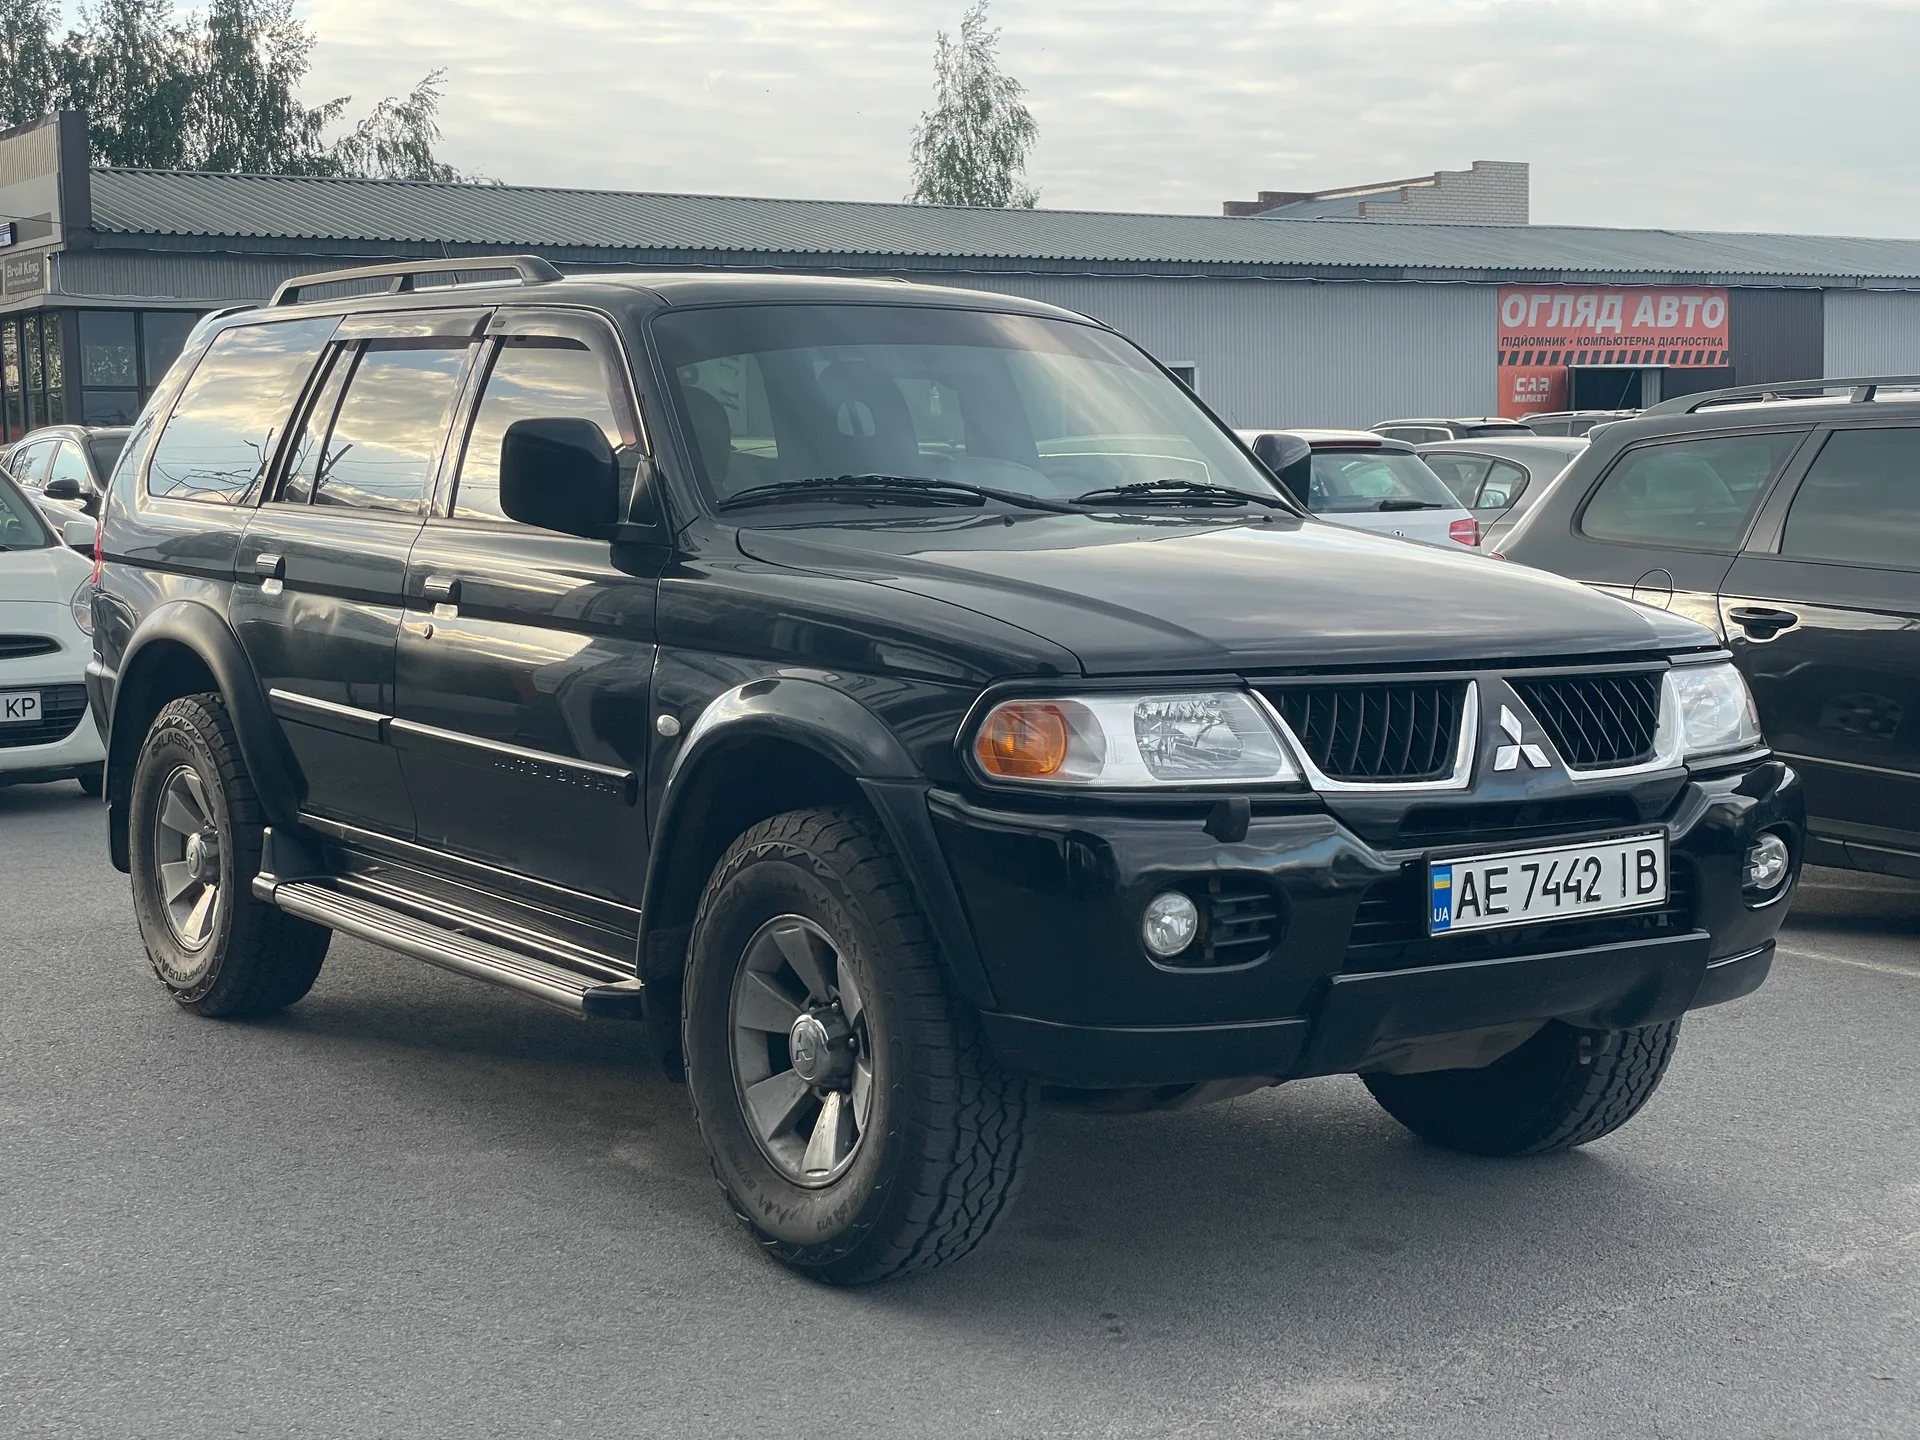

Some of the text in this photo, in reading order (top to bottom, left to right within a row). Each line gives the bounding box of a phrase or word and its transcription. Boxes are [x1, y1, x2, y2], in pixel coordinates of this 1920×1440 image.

[1501, 294, 1726, 334] ОГЛЯД АВТО
[1501, 334, 1723, 348] ПІДЙОМНИК КОМПЬЮТЕРНА ДІАГНОСТІКА
[1515, 377, 1550, 392] CAR
[1514, 394, 1548, 403] MARKET
[6, 697, 36, 718] KP
[1455, 848, 1658, 920] AE 7442 IB
[1434, 905, 1449, 923] UA
